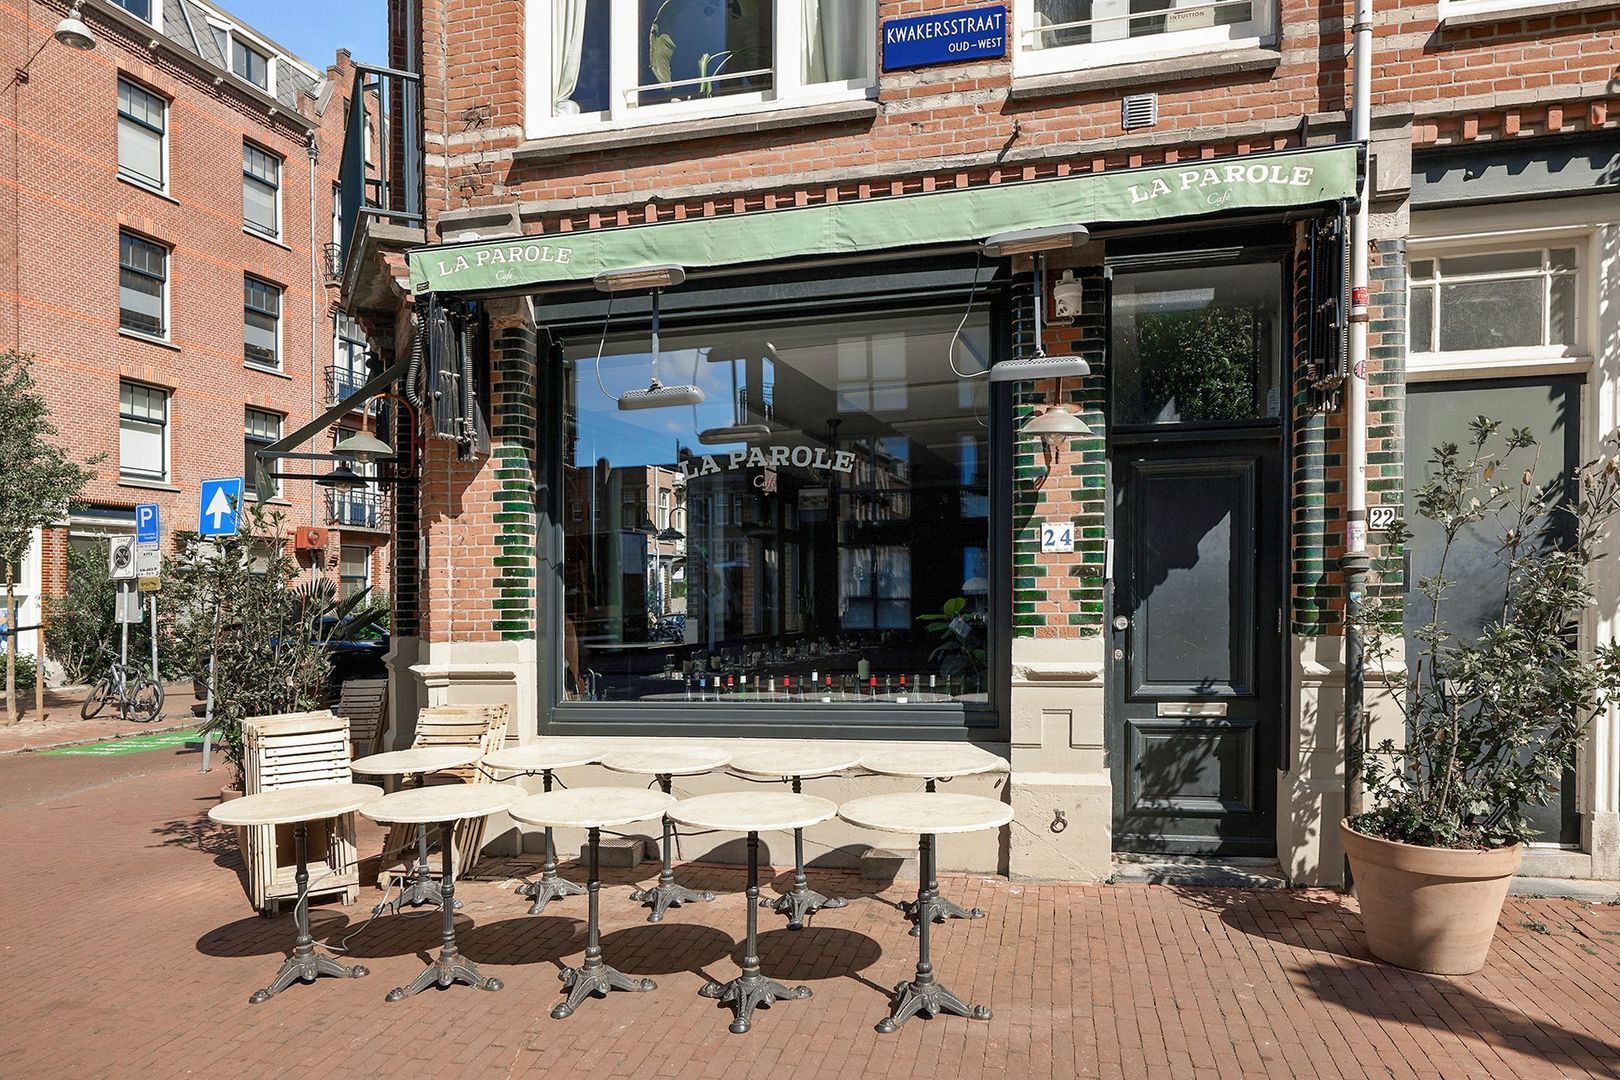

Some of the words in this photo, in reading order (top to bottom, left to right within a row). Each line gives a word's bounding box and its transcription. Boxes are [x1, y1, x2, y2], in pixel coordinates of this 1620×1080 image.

[1169, 10, 1205, 21] INTUITION
[887, 13, 1002, 44] KWAKERSSTRAAT
[948, 37, 1002, 53] OUD-WEST
[1127, 176, 1172, 204] LA
[1178, 164, 1314, 191] PAROLE
[437, 255, 470, 277] LA
[475, 246, 573, 267] PAROLE
[678, 453, 722, 481] LA
[728, 445, 856, 474] PAROLE
[140, 507, 153, 528] P
[1371, 509, 1394, 528] 22
[1043, 528, 1072, 547] 24
